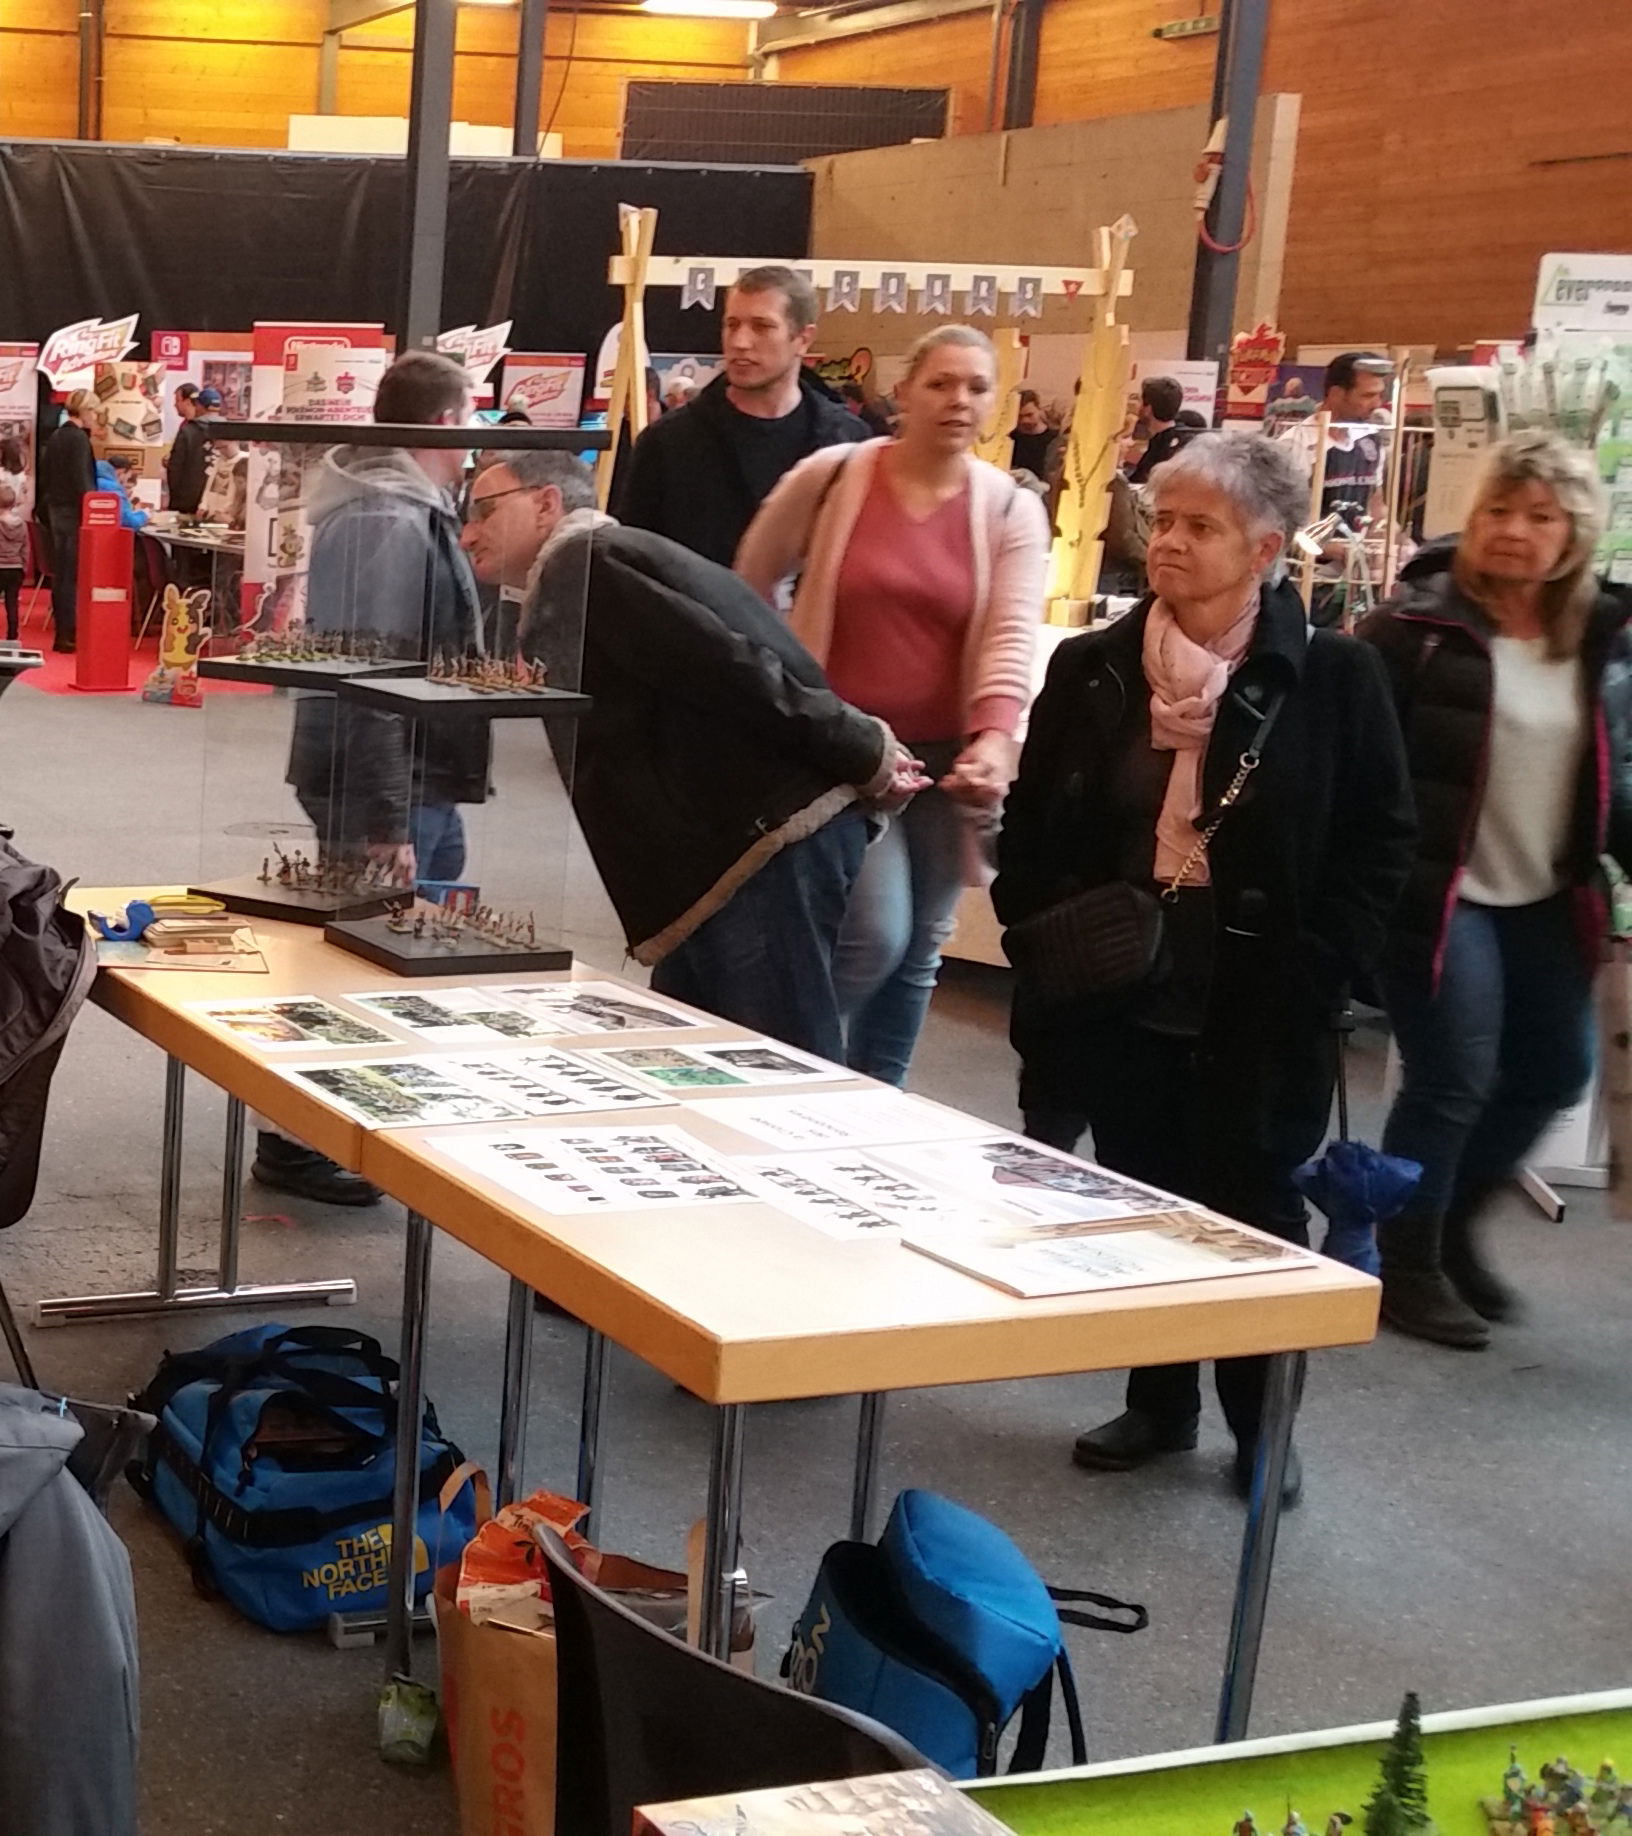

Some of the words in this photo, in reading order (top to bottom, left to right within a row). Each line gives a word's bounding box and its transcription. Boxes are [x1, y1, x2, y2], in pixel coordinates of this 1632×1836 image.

[335, 1528, 385, 1558] THE
[303, 1548, 387, 1588] NORTH
[328, 1568, 389, 1600] FACE
